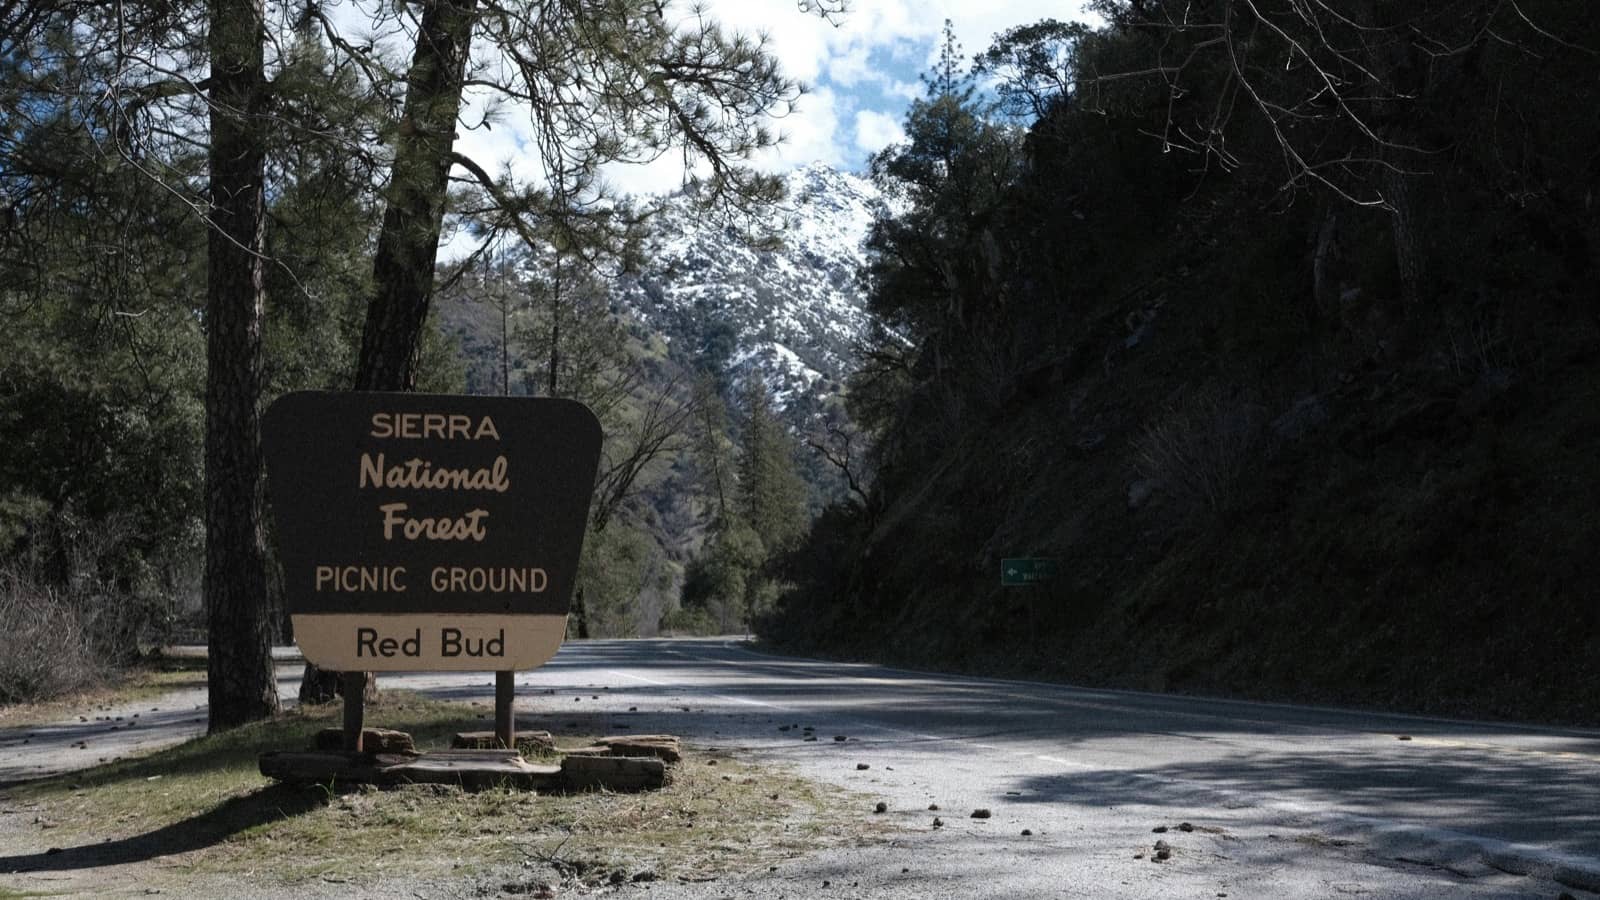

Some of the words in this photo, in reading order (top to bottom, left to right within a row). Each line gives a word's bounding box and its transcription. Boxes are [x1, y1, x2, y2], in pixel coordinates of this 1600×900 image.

[371, 413, 500, 438] SIERRA
[359, 453, 510, 492] National
[380, 503, 489, 541] Forest
[315, 566, 407, 592] PICNIC
[430, 567, 549, 593] GROUND
[356, 627, 422, 658] Red
[440, 628, 505, 658] Bud
